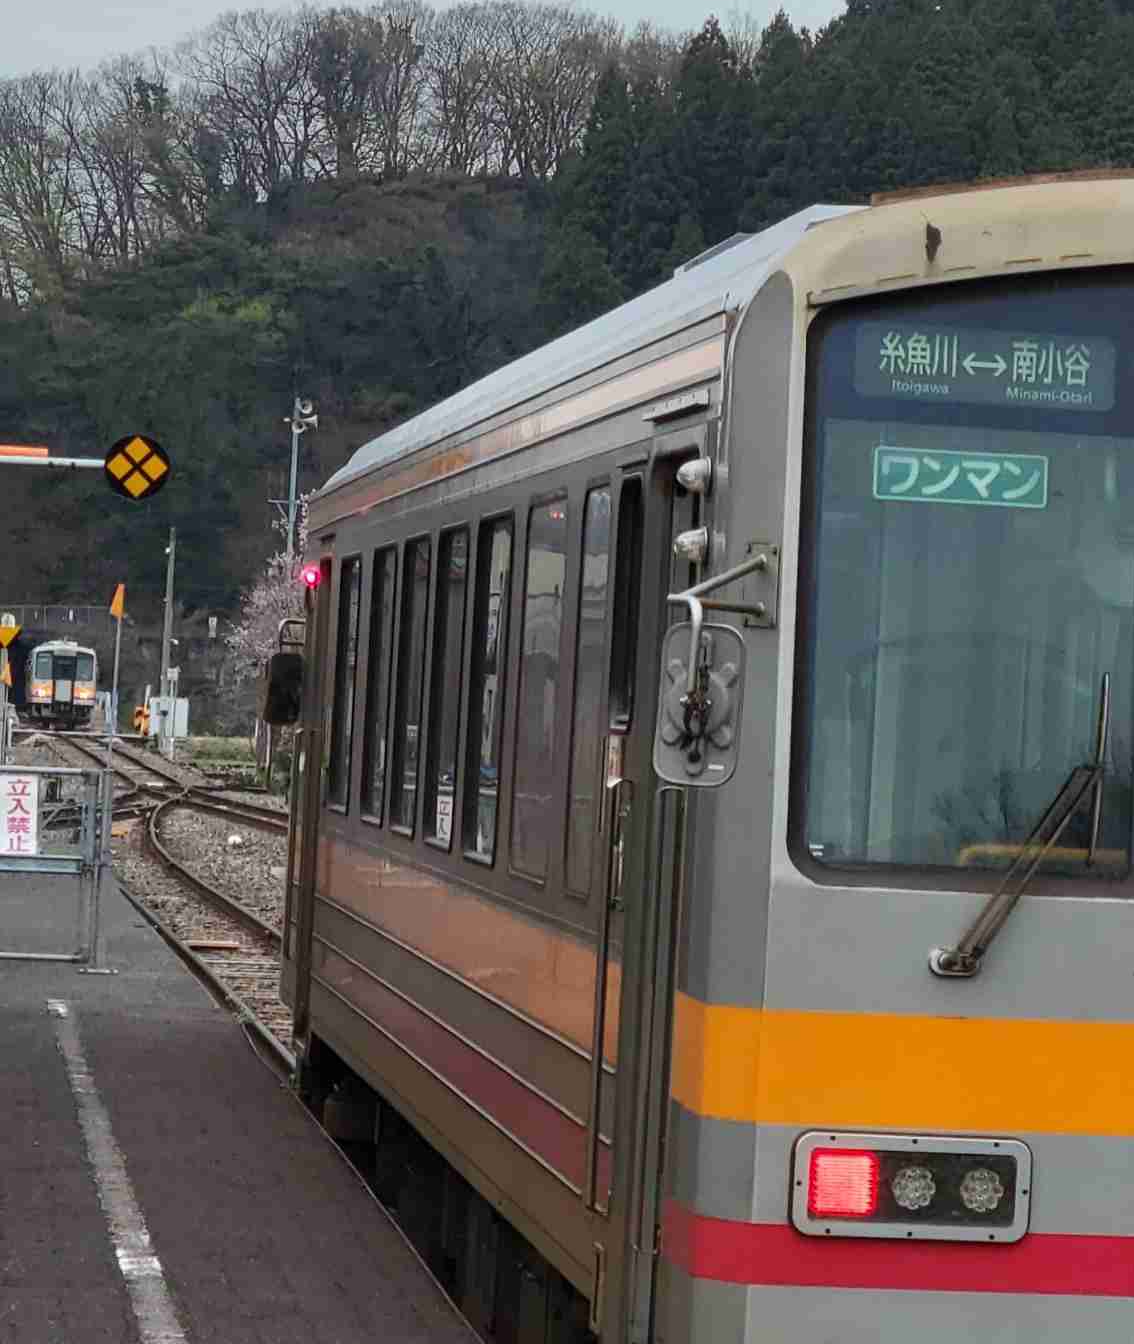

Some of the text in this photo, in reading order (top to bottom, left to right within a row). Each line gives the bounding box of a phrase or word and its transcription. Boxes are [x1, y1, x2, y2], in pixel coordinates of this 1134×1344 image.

[879, 331, 959, 377] 糸魚川
[1011, 340, 1091, 386] 南小谷
[891, 379, 950, 395] Itoigawa
[1005, 387, 1093, 404] Minami-Otari
[881, 456, 1041, 499] ワンマン
[6, 778, 32, 853] 立入禁止
